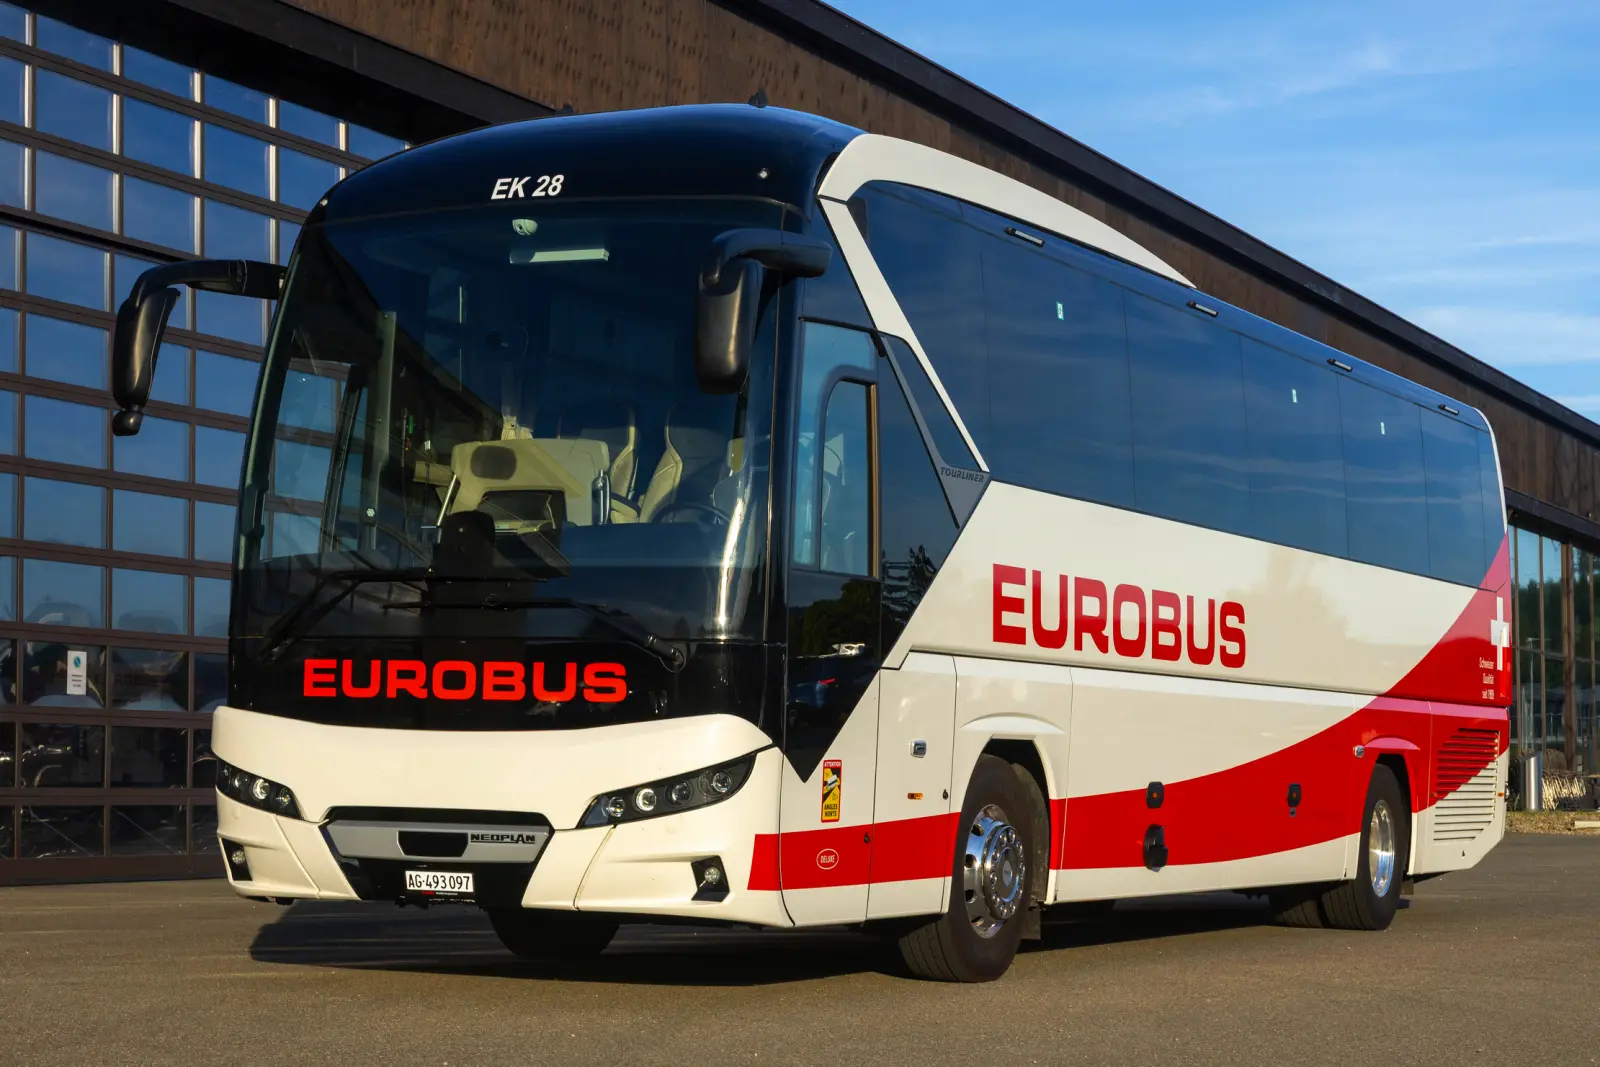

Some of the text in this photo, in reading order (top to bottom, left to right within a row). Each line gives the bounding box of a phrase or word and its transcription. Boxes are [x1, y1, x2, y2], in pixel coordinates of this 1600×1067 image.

[490, 174, 565, 200] EK 28
[940, 467, 984, 483] TOURLINER
[992, 563, 1246, 669] EUROBUS
[303, 658, 628, 703] EUROBUS
[470, 833, 536, 844] NEOPLAN
